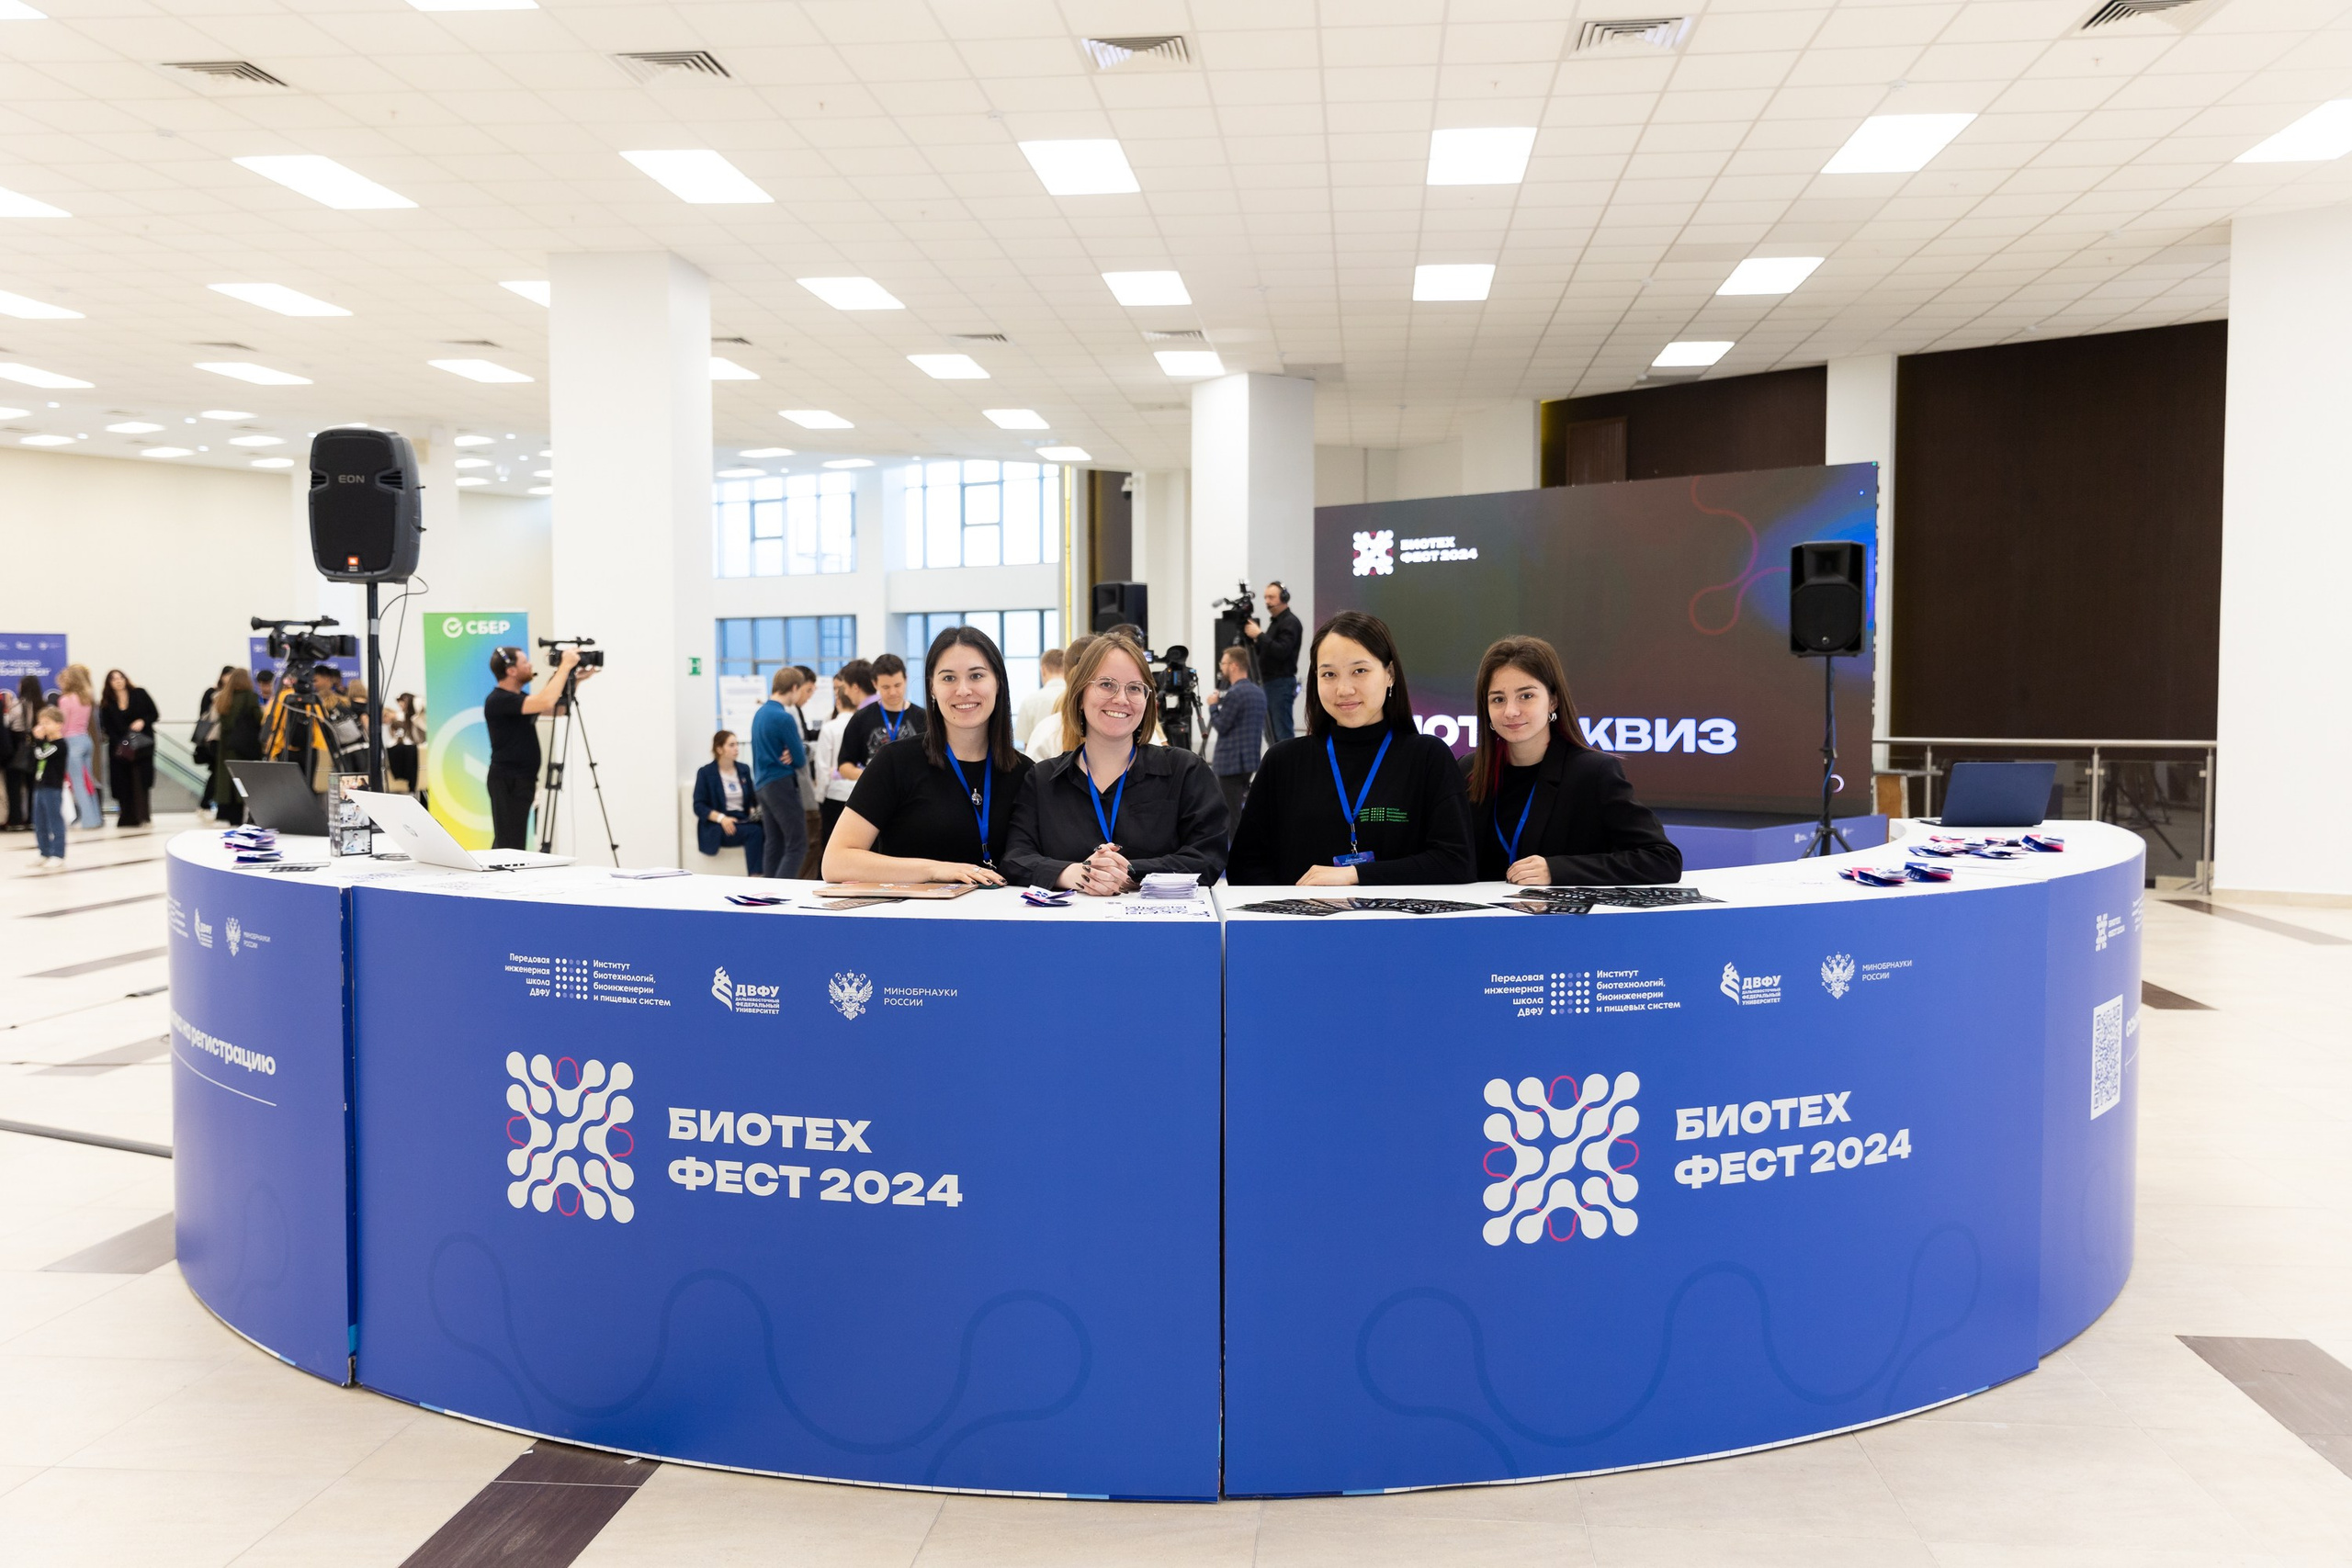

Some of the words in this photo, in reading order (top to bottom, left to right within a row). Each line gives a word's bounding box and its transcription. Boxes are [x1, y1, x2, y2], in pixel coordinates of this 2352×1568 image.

[338, 474, 365, 484] EON
[1399, 536, 1456, 551] БИОТЕХ
[1439, 547, 1478, 561] 2024
[465, 620, 511, 635] СБЕР
[1578, 716, 1737, 755] КВИЗ
[510, 953, 550, 964] Передовая
[504, 964, 550, 976] инженерная
[593, 960, 630, 971] Институт
[1862, 960, 1913, 972] МИНОБРНАУКИ
[593, 970, 656, 984] биотехнологий,
[1490, 974, 1544, 984] Передовая
[1596, 969, 1639, 979] Институт
[1861, 972, 1890, 982] РОССИИ
[526, 977, 550, 987] школа
[593, 982, 654, 994] биоинженерии
[1596, 977, 1666, 990] биотехнологий,
[1742, 975, 1781, 990] ДВФУ
[529, 987, 550, 998] ДВФУ
[735, 984, 780, 998] ДВФУ
[884, 987, 957, 997] МИНОБРНАУКИ
[1484, 985, 1544, 995] инженерная
[1596, 990, 1664, 1001] биоинженерии
[600, 994, 638, 1005] пищевых
[639, 998, 672, 1007] систем
[884, 998, 923, 1007] РОССИИ
[1512, 997, 1544, 1005] школа
[1742, 998, 1781, 1006] УНИВЕРСИТЕТ
[735, 1007, 780, 1015] УНИВЕРСИТЕТ
[1517, 1007, 1544, 1017] ДВФУ
[1603, 1003, 1645, 1013] пищевых
[1647, 1001, 1680, 1010] систем
[191, 1026, 276, 1076] регистрацию
[1675, 1090, 1852, 1141] БИОТЕХ
[668, 1107, 873, 1154] БИОТЕХ
[1674, 1144, 1804, 1189] ФЕСТ
[1810, 1128, 1912, 1174] 2024
[668, 1156, 811, 1199] ФЕСТ
[819, 1168, 963, 1207] 2024
